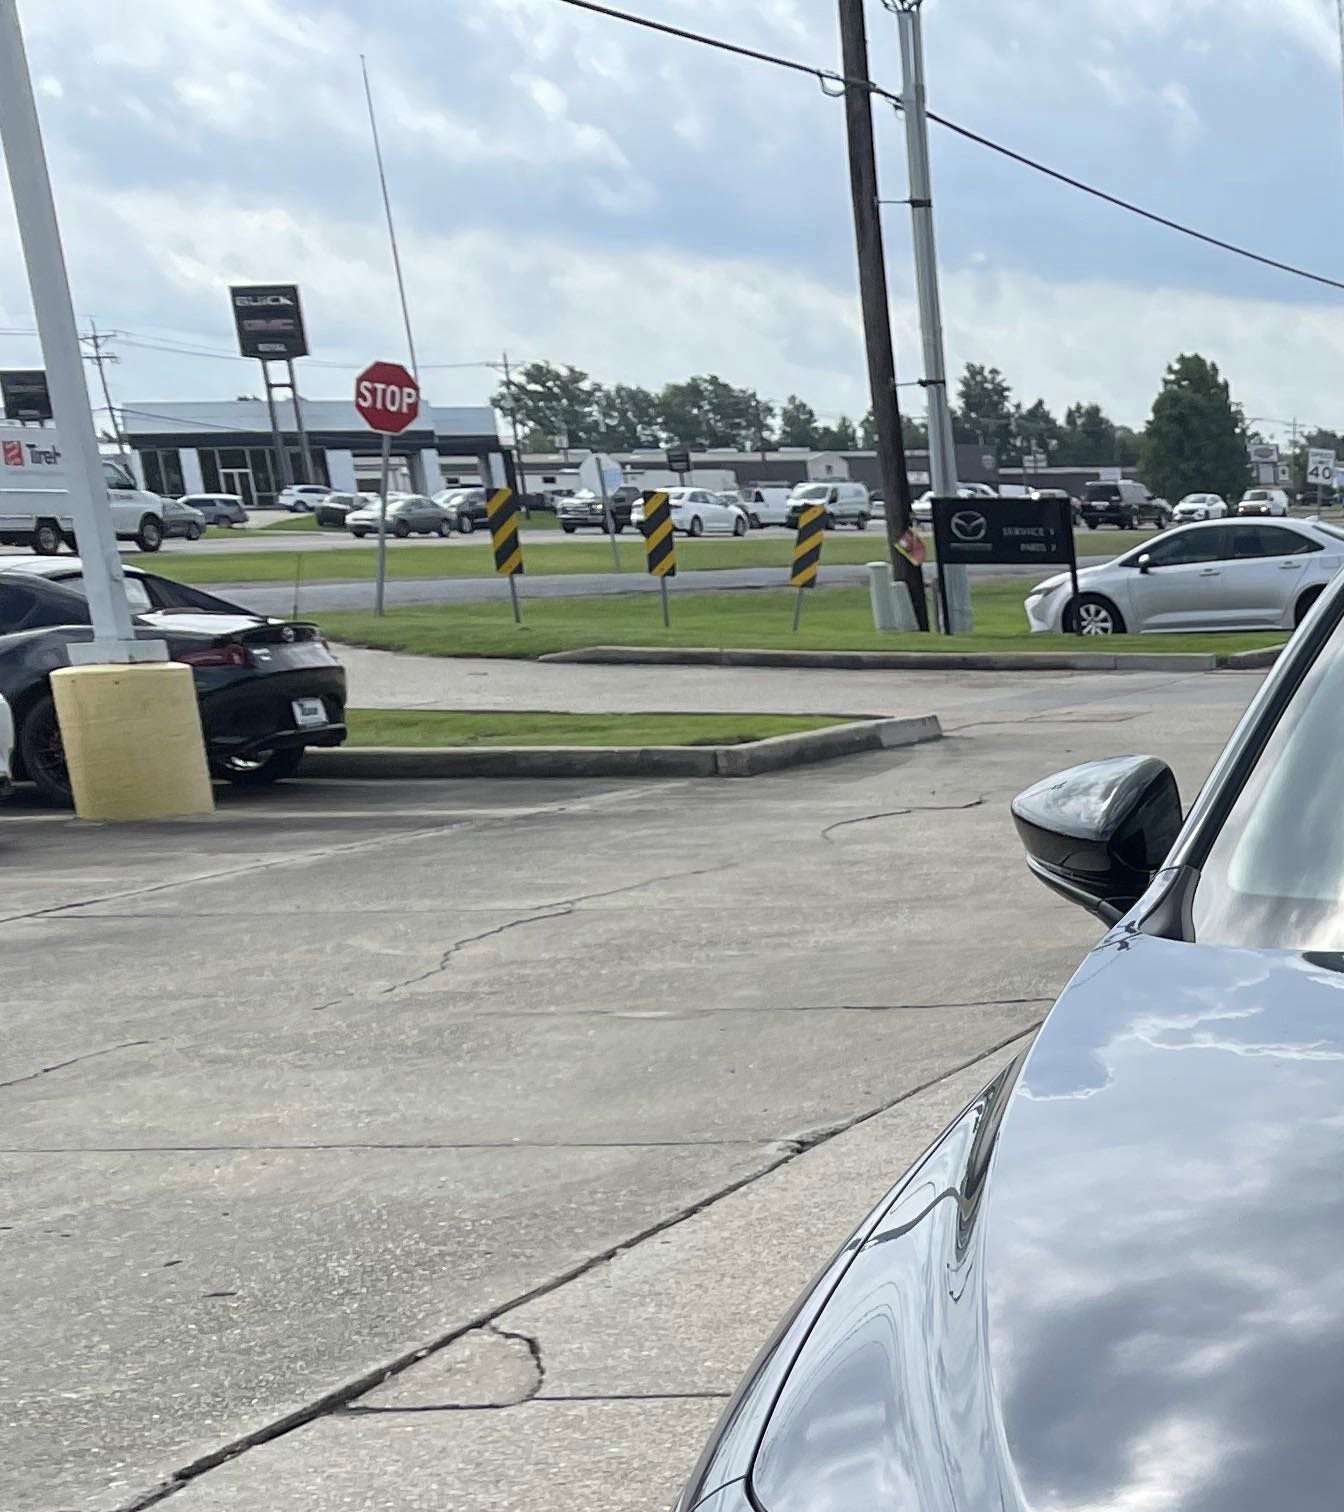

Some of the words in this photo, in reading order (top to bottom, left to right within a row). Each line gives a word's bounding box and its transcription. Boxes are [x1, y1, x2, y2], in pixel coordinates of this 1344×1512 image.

[234, 295, 294, 306] BUICK
[358, 381, 417, 413] STOP
[1309, 466, 1331, 480] 40
